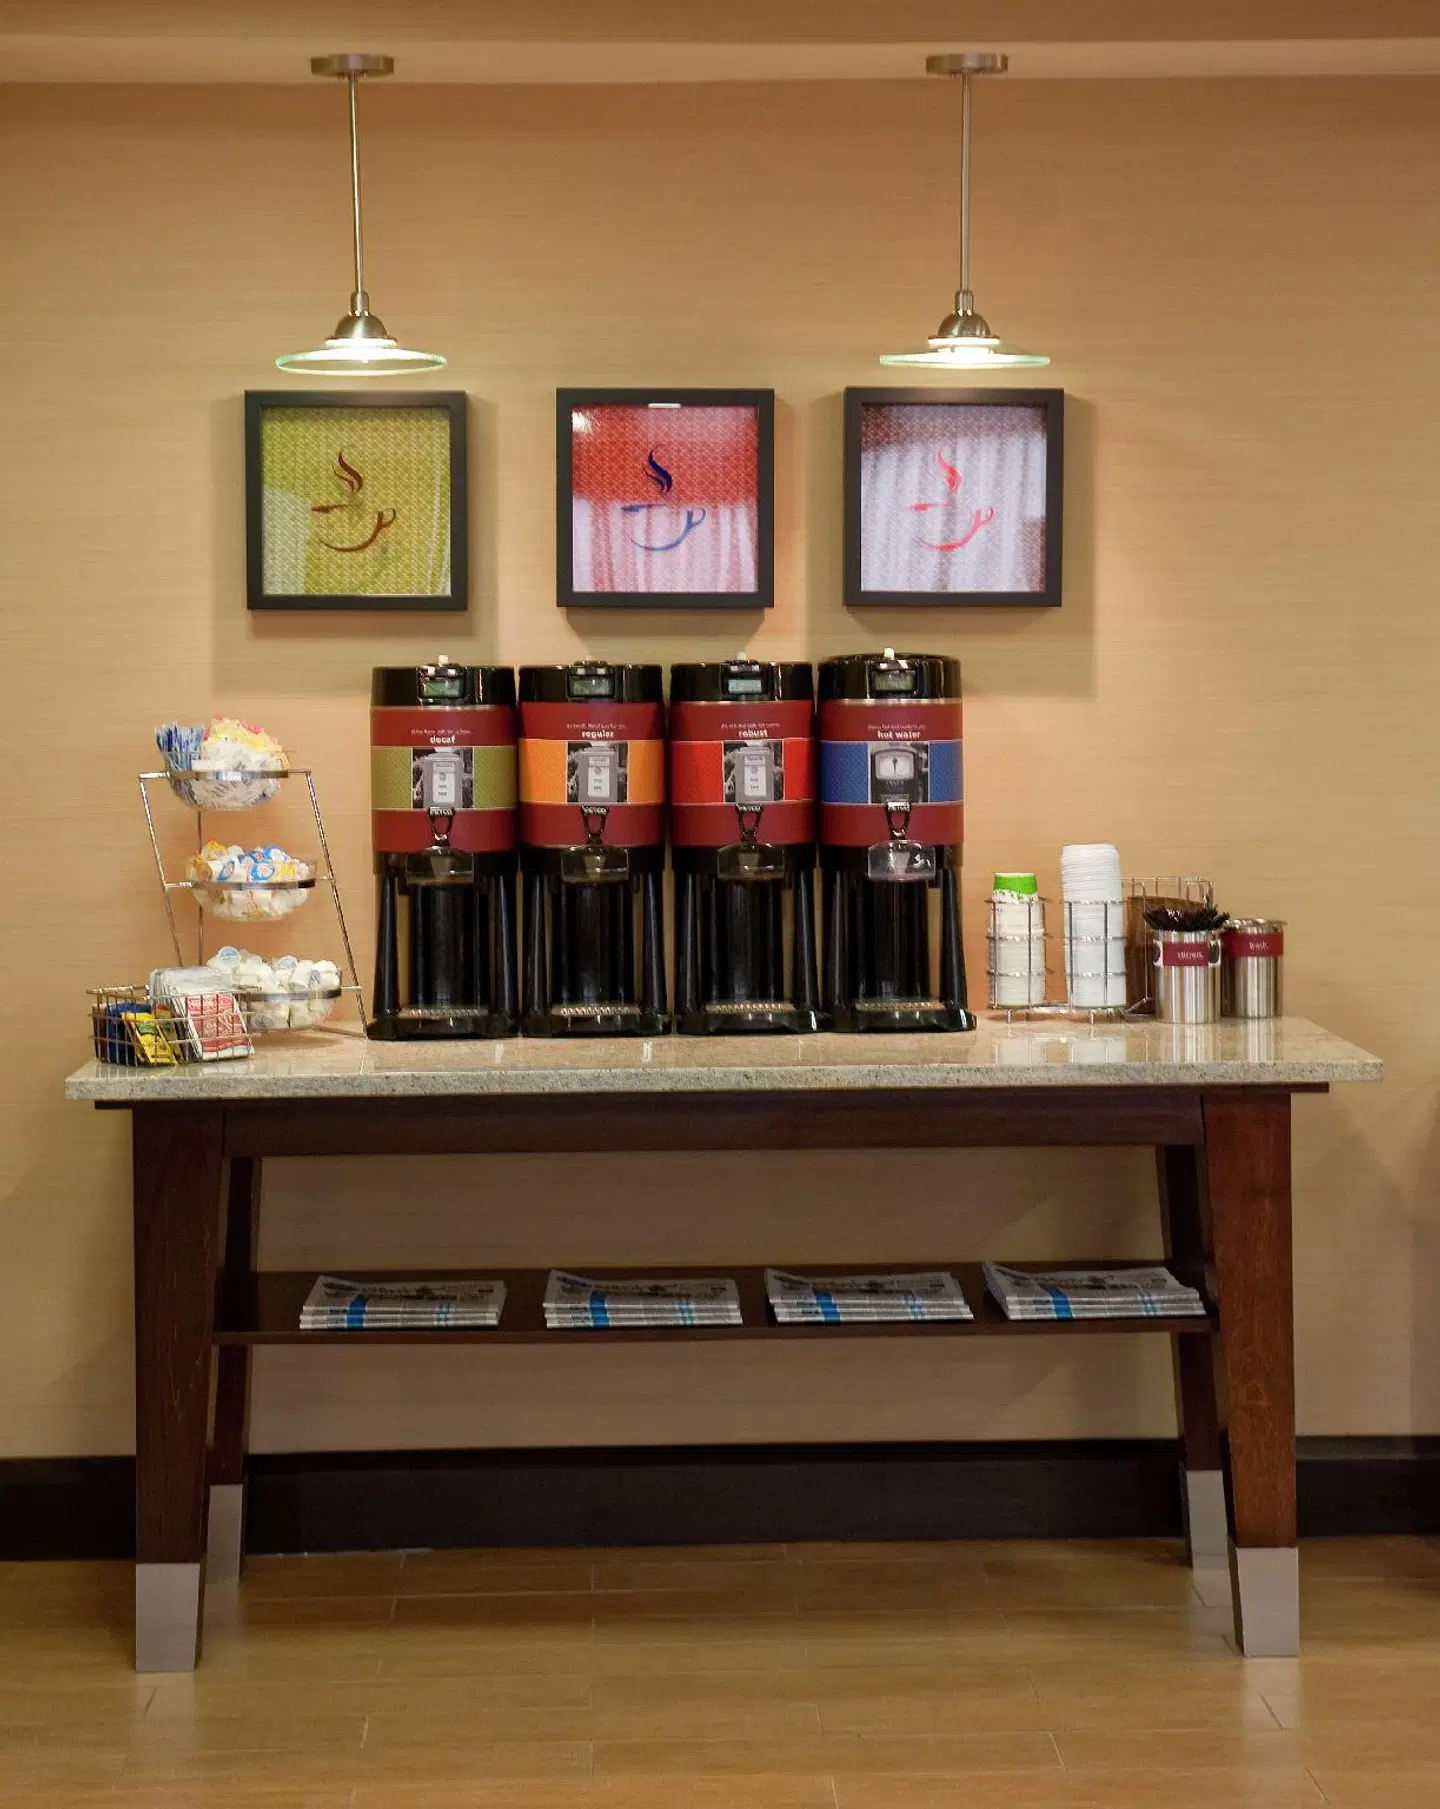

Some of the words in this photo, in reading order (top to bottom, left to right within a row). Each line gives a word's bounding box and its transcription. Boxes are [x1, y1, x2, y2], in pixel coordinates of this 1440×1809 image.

[581, 730, 615, 740] regular
[738, 729, 768, 738] robust
[877, 729, 894, 739] hot
[895, 730, 921, 739] water
[429, 735, 456, 744] decaf
